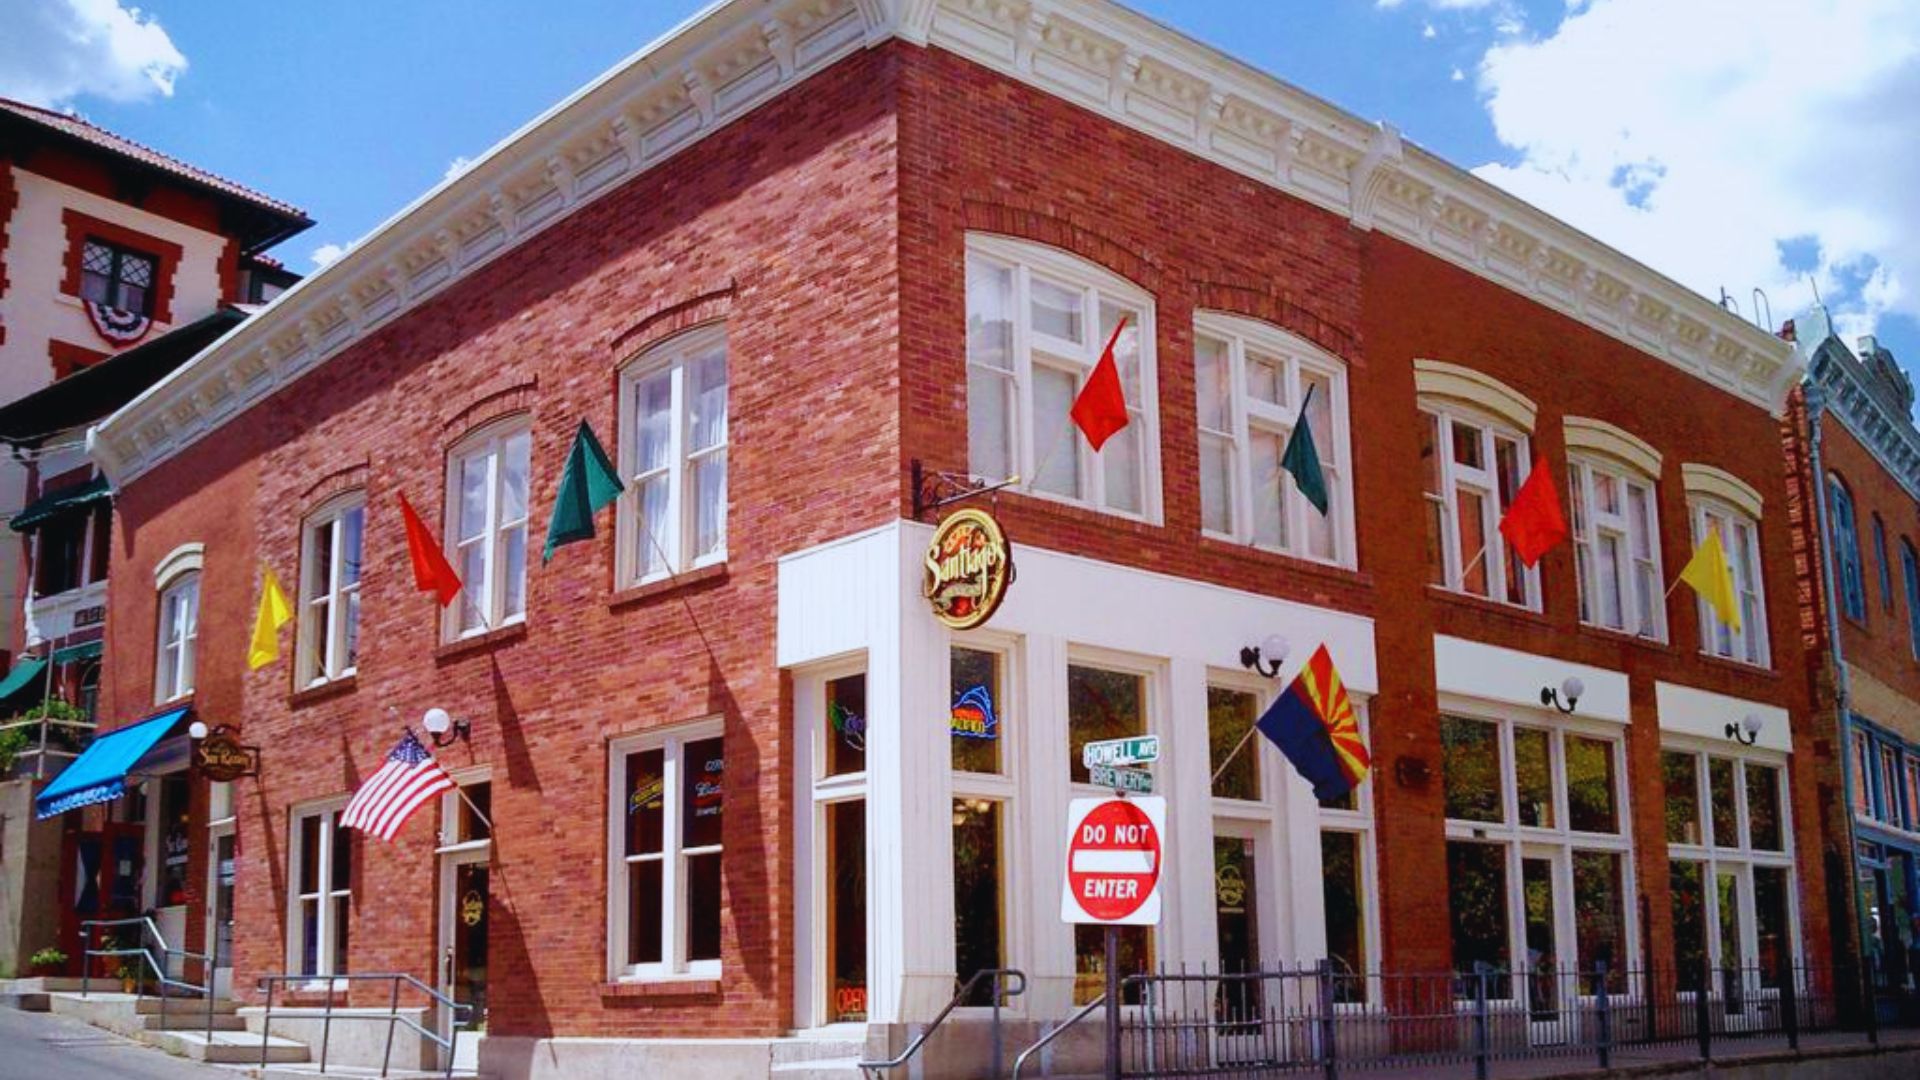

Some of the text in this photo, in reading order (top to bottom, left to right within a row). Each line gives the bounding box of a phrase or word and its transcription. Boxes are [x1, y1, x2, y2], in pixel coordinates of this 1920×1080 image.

[948, 717, 985, 733] ACIFICO
[1085, 740, 1157, 765] HOWELL AVE
[1092, 765, 1143, 790] BREWERY
[1083, 824, 1149, 844] DO NOT
[1084, 879, 1138, 899] ENTER
